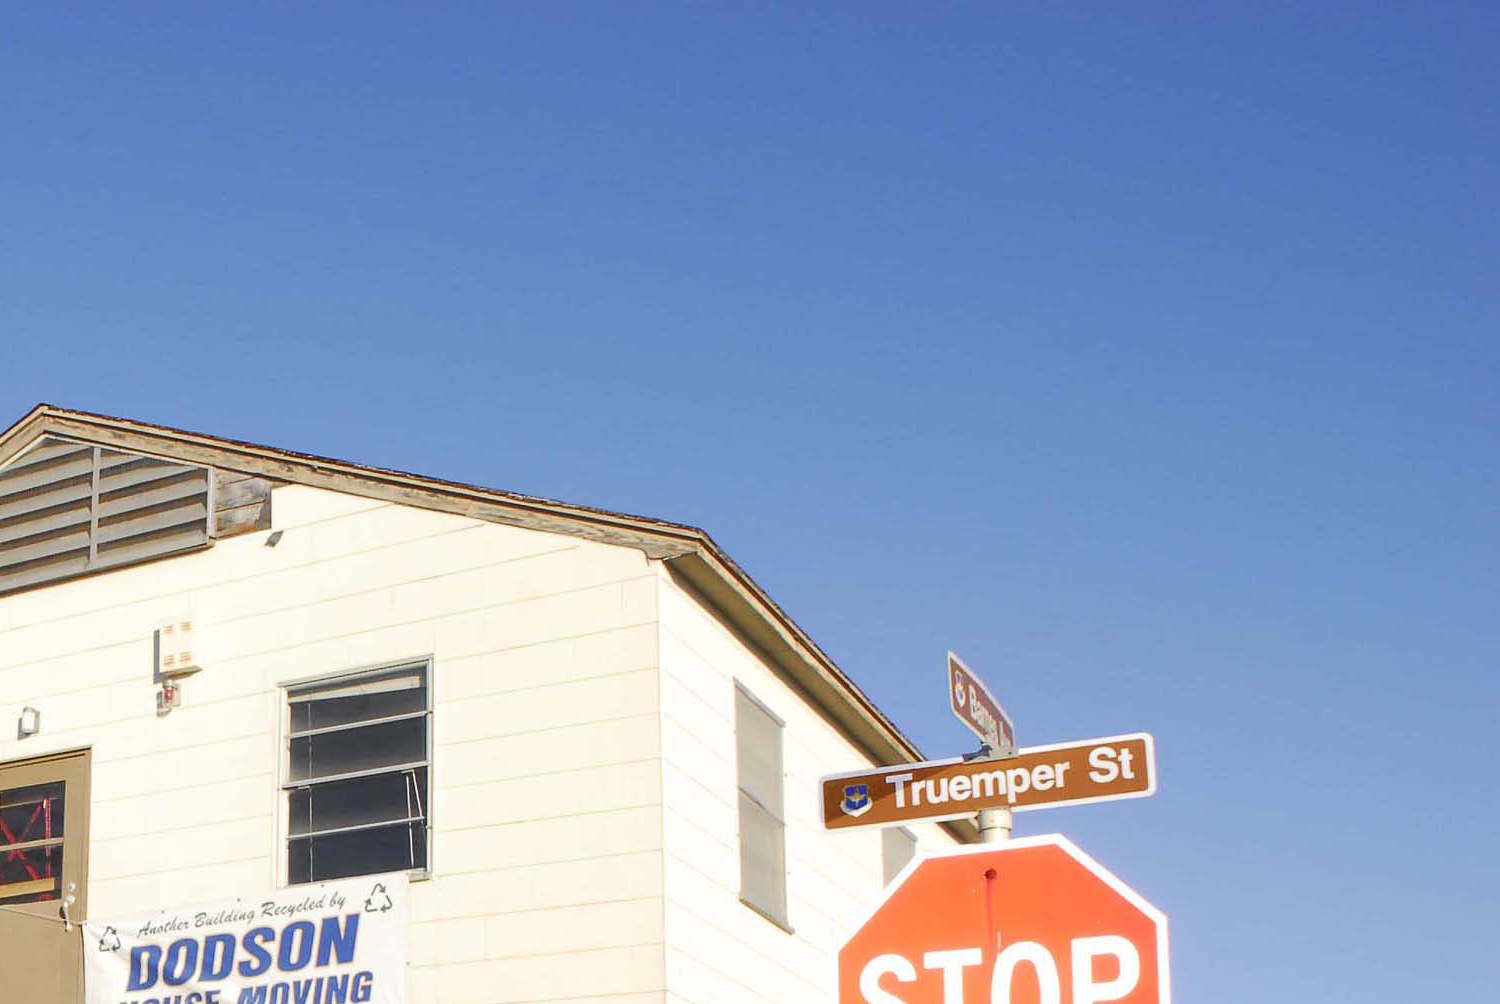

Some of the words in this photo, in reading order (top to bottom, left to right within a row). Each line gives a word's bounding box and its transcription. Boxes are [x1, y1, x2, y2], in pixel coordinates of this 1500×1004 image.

[885, 760, 1071, 809] Truemper
[1088, 746, 1135, 783] St
[137, 918, 190, 939] Another
[194, 909, 256, 929] Building
[260, 894, 325, 917] Recycled
[329, 891, 347, 910] by
[126, 913, 362, 993] DODSON
